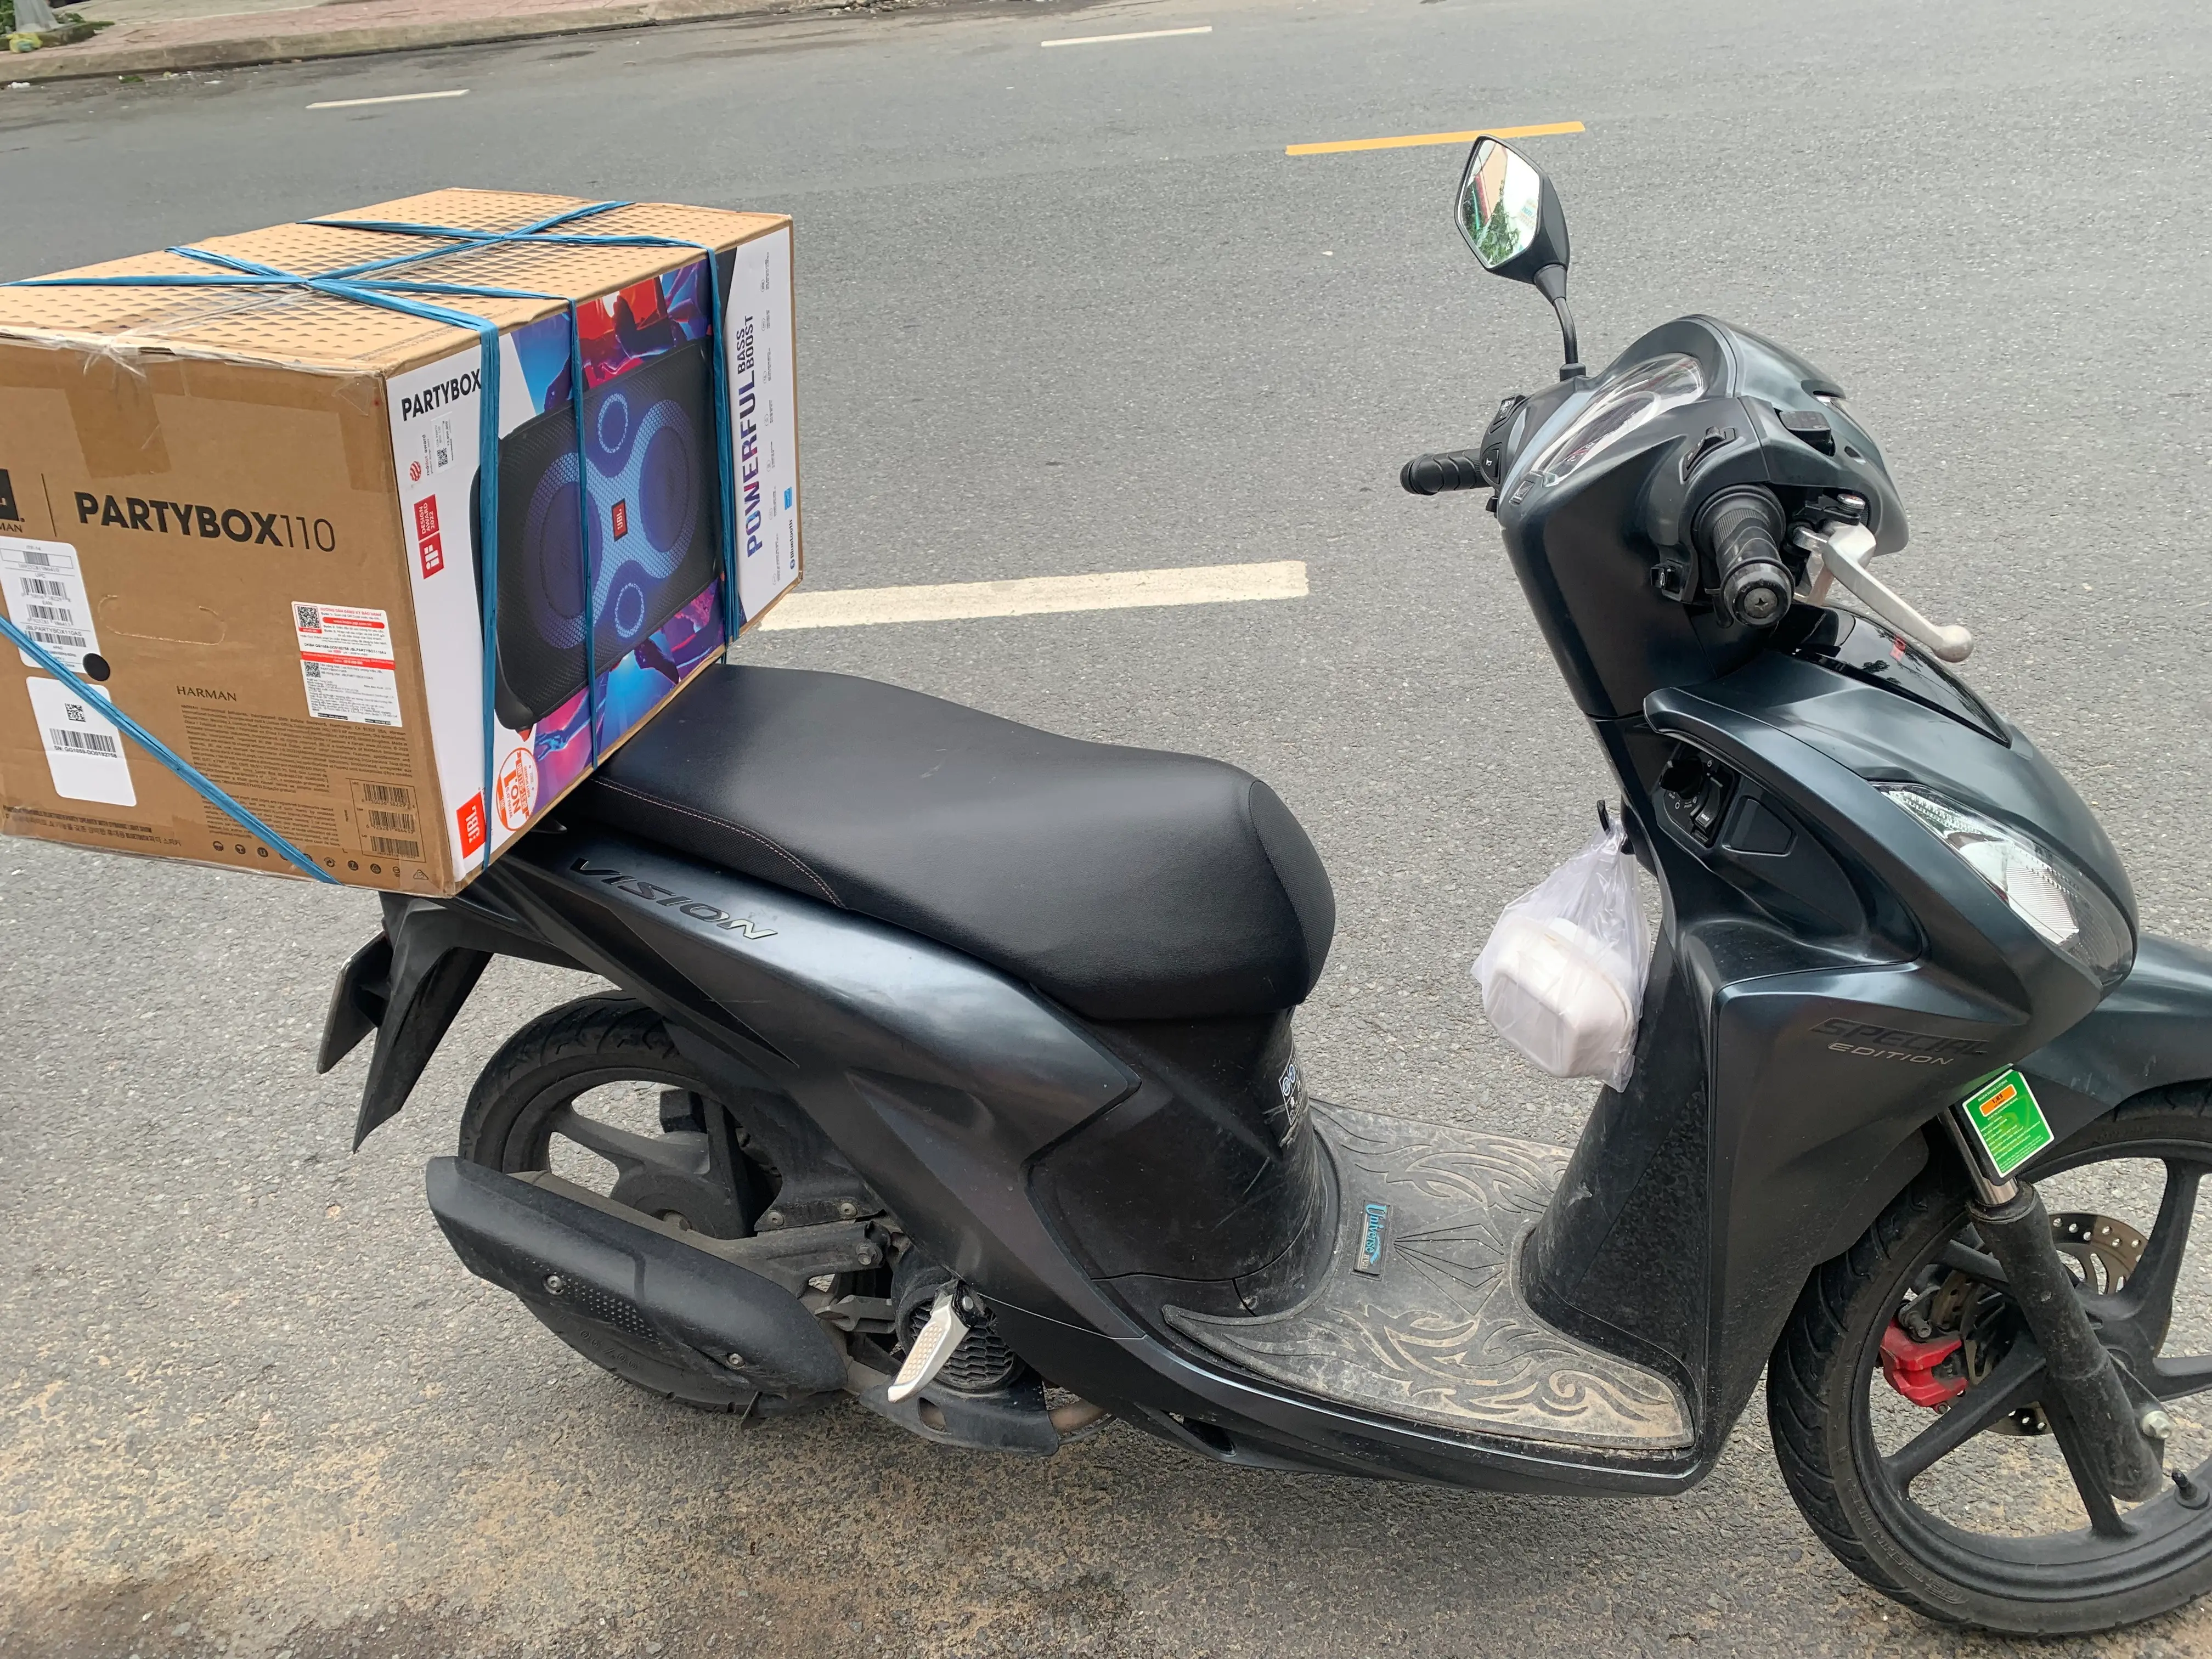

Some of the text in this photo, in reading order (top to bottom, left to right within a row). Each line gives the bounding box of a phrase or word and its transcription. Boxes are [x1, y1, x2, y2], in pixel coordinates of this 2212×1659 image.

[736, 329, 746, 375] BASS
[744, 315, 754, 370] BOOST
[401, 368, 481, 421] PARTYBOX
[738, 370, 763, 558] POWERFUL
[74, 490, 336, 552] PARTYBOX110
[177, 685, 237, 703] HARMAN
[465, 805, 480, 844] JBL
[570, 857, 778, 940] VISION
[1809, 1018, 1990, 1056] SPECIAL
[1828, 1043, 1954, 1065] EDITION
[1365, 1204, 1387, 1254] Universe
